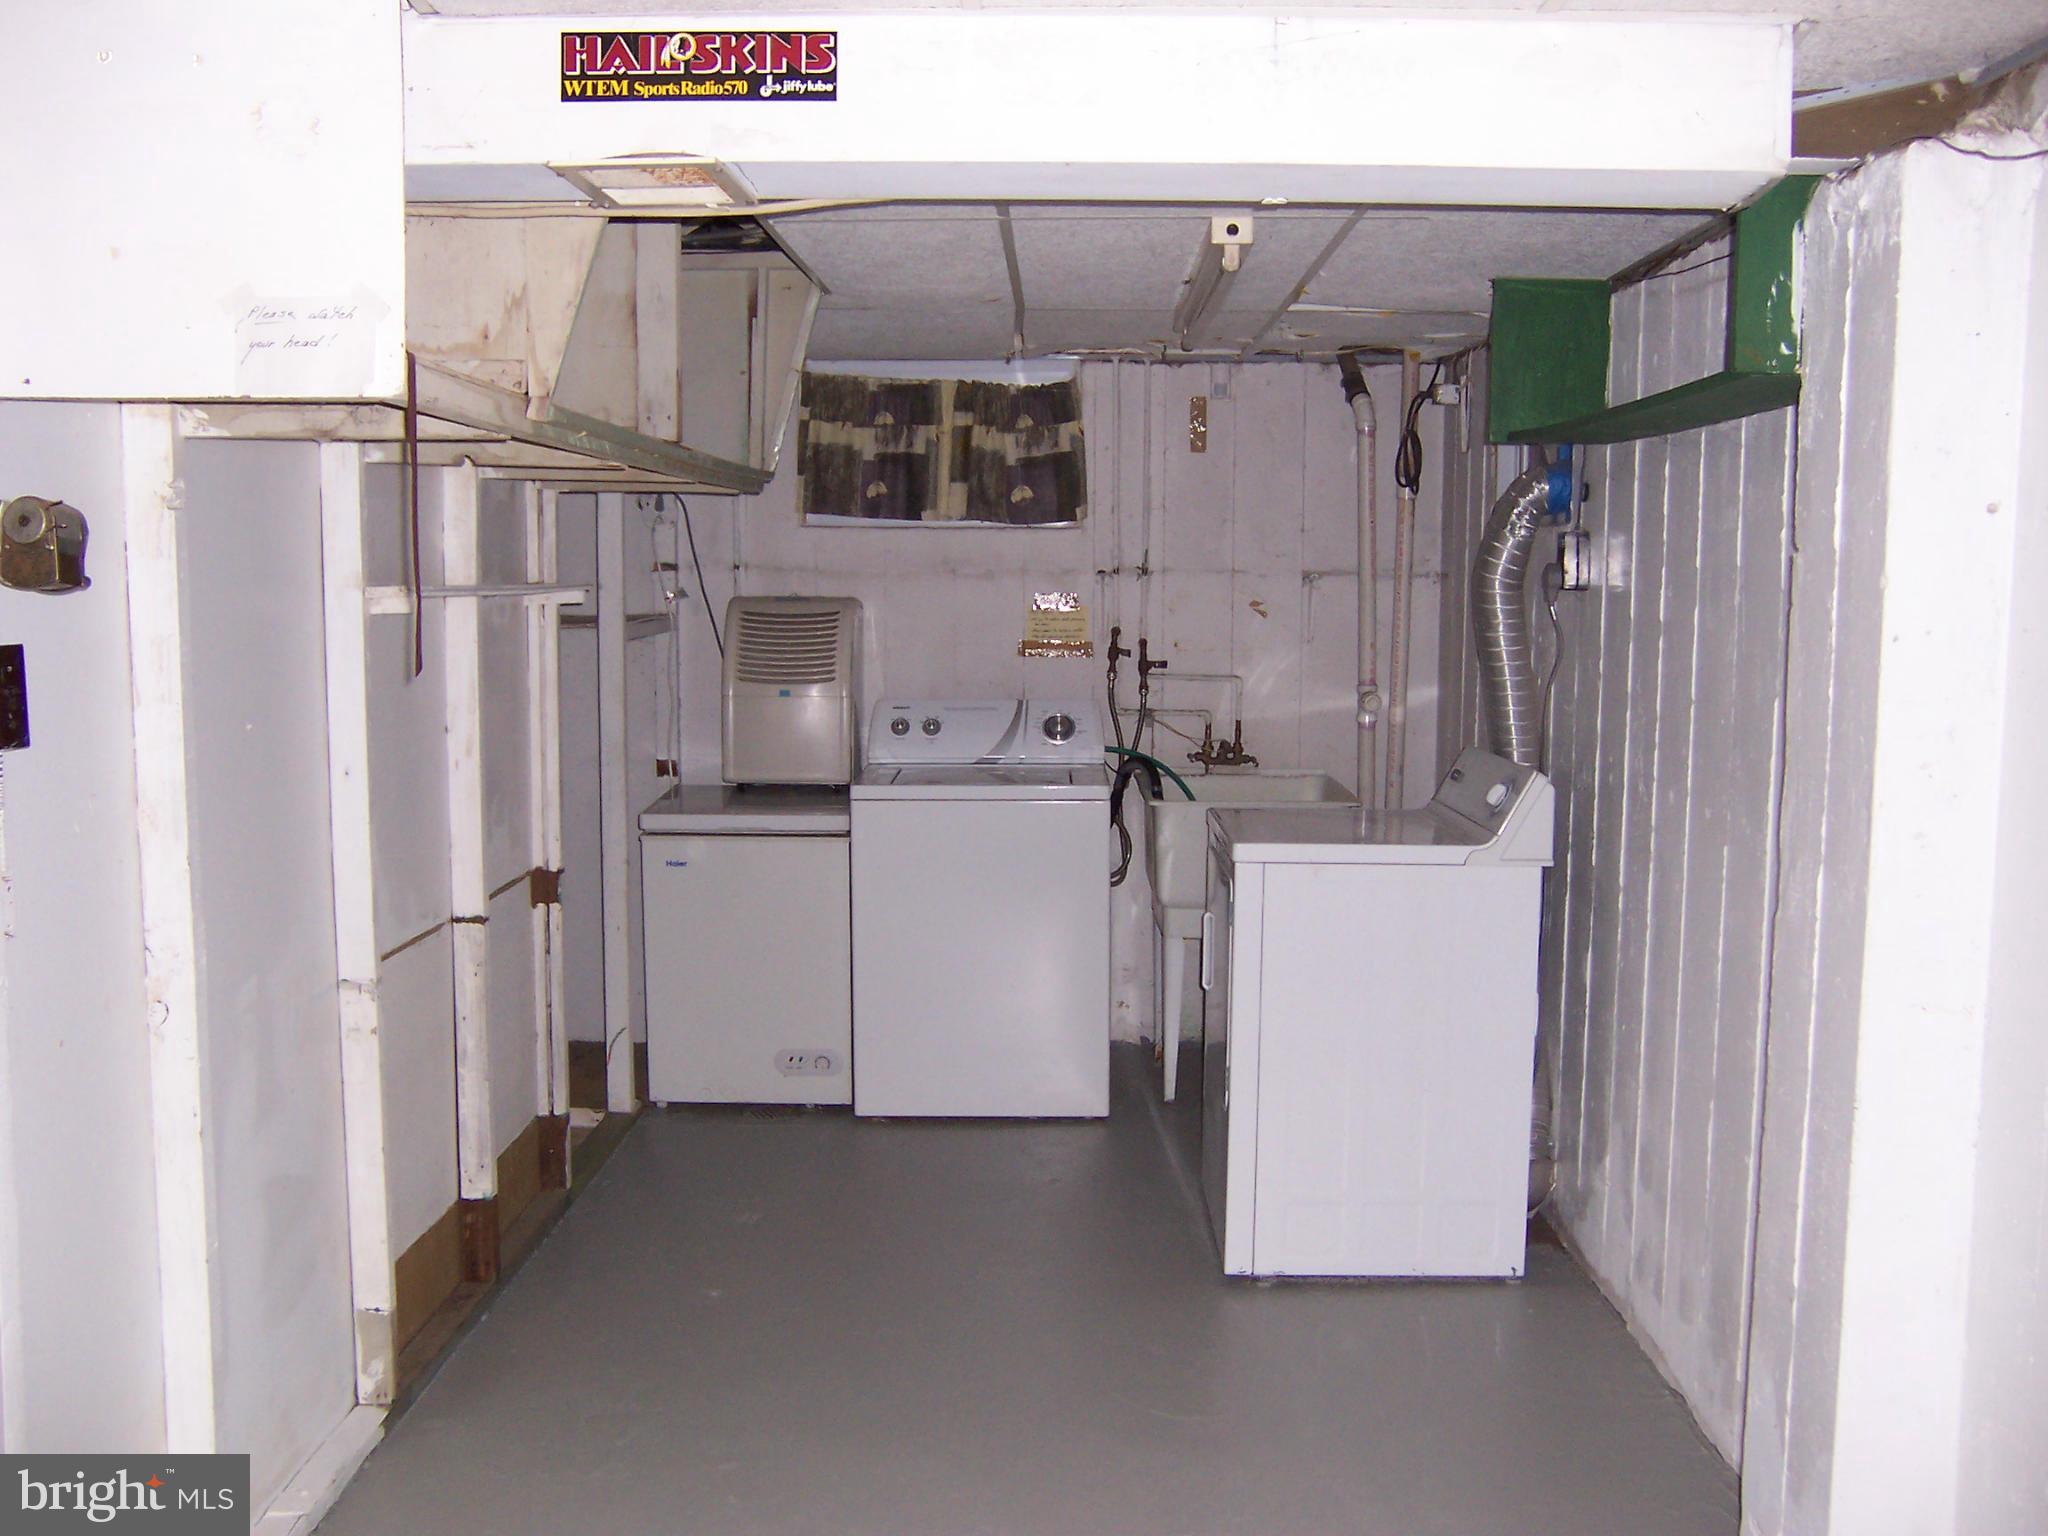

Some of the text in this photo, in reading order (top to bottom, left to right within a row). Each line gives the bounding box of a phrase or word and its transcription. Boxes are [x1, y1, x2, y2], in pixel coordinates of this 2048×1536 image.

[690, 33, 836, 75] SKINS
[564, 80, 629, 97] WTEM
[248, 306, 358, 320] Please watch
[240, 340, 276, 365] your
